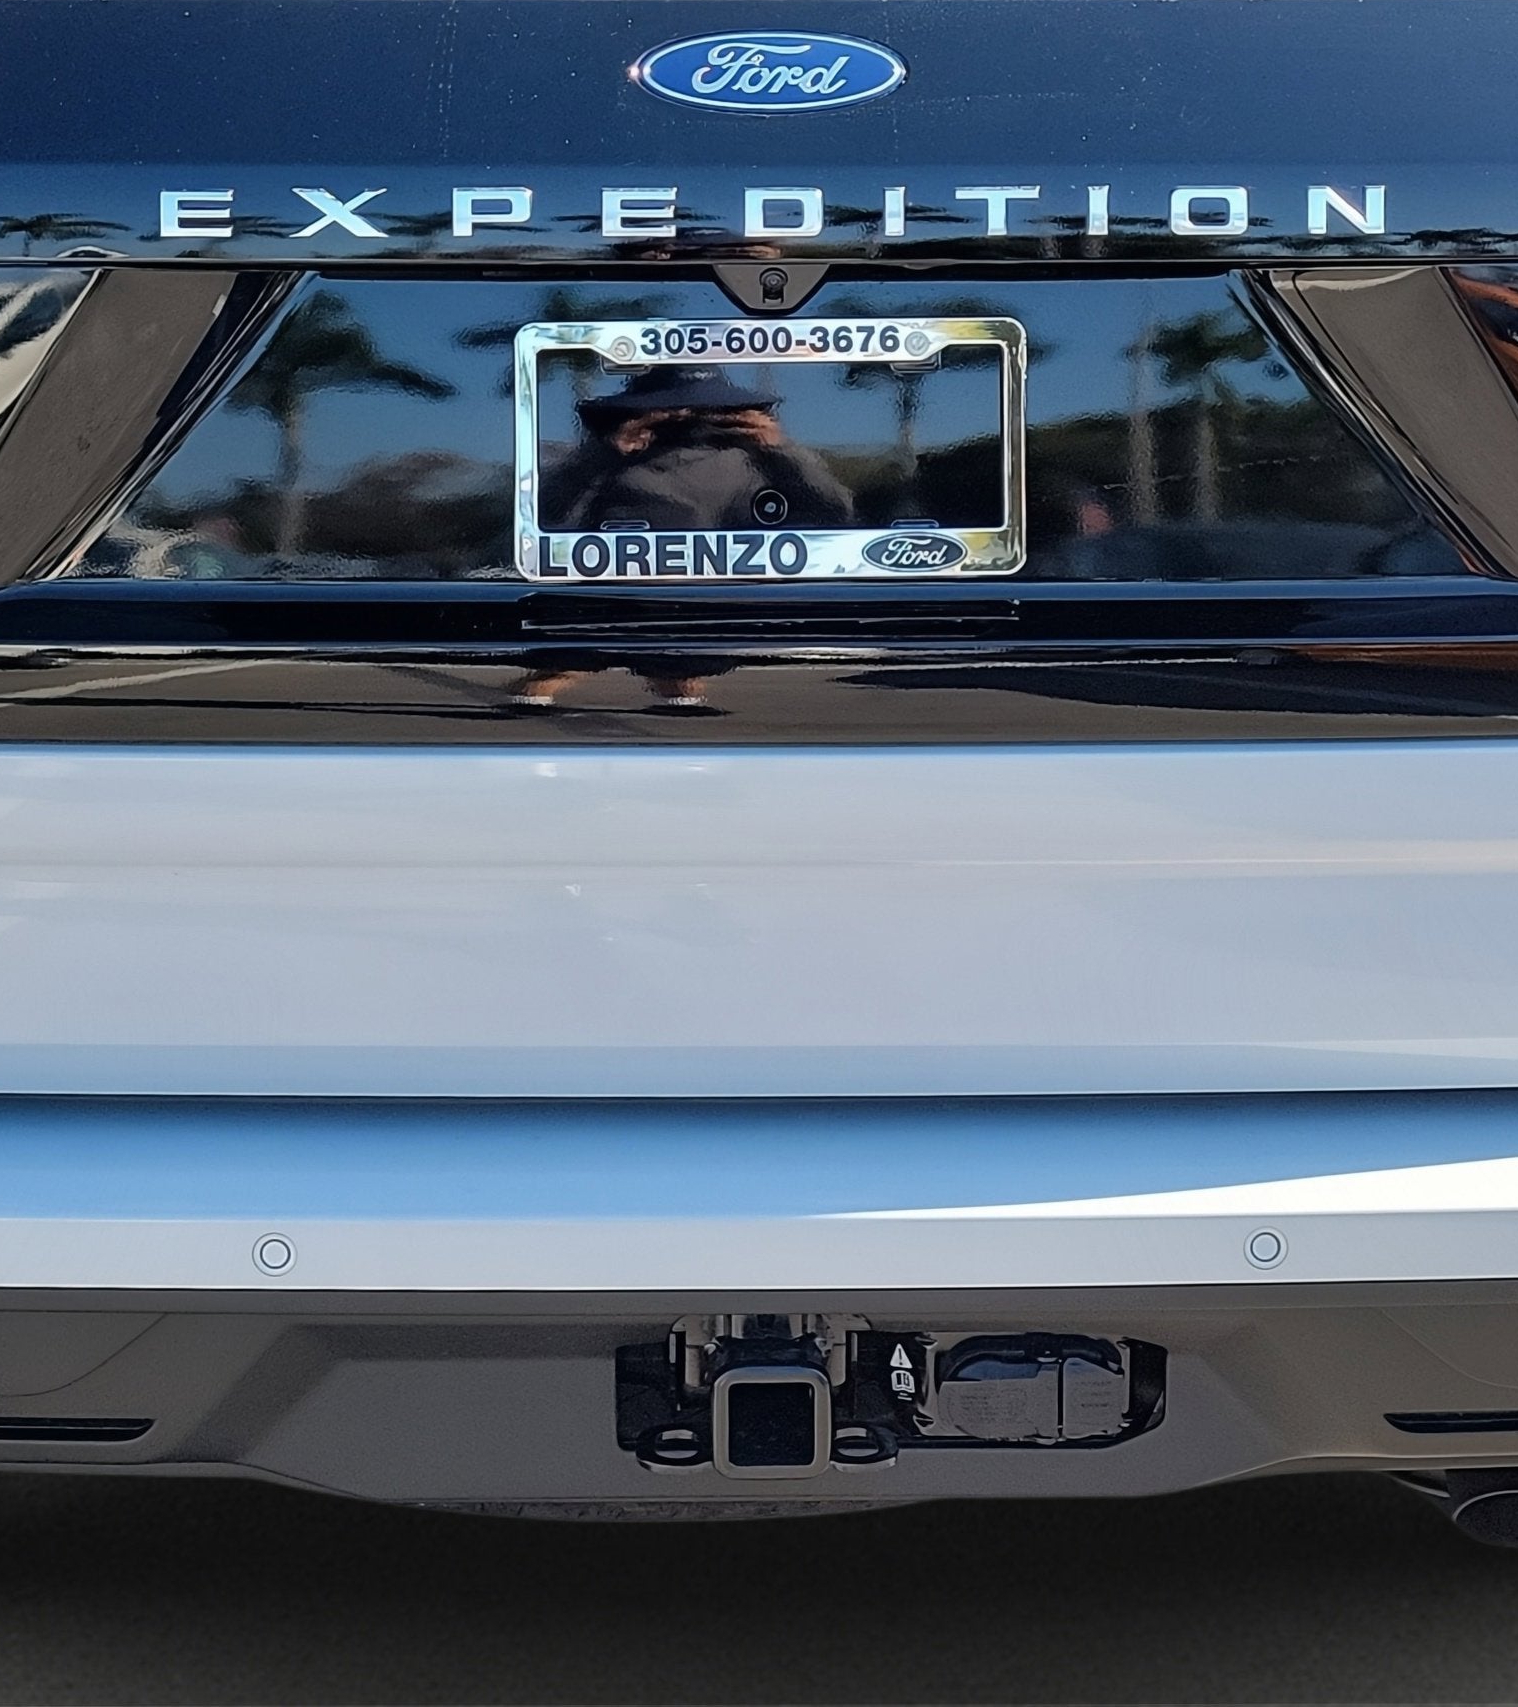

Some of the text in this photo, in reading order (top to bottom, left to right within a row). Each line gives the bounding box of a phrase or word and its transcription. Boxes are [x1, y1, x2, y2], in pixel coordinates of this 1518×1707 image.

[691, 43, 850, 94] Ford
[157, 185, 1388, 242] EXPEDITION
[640, 325, 900, 356] 305-600-3676
[538, 533, 948, 577] LORENZO Ford
